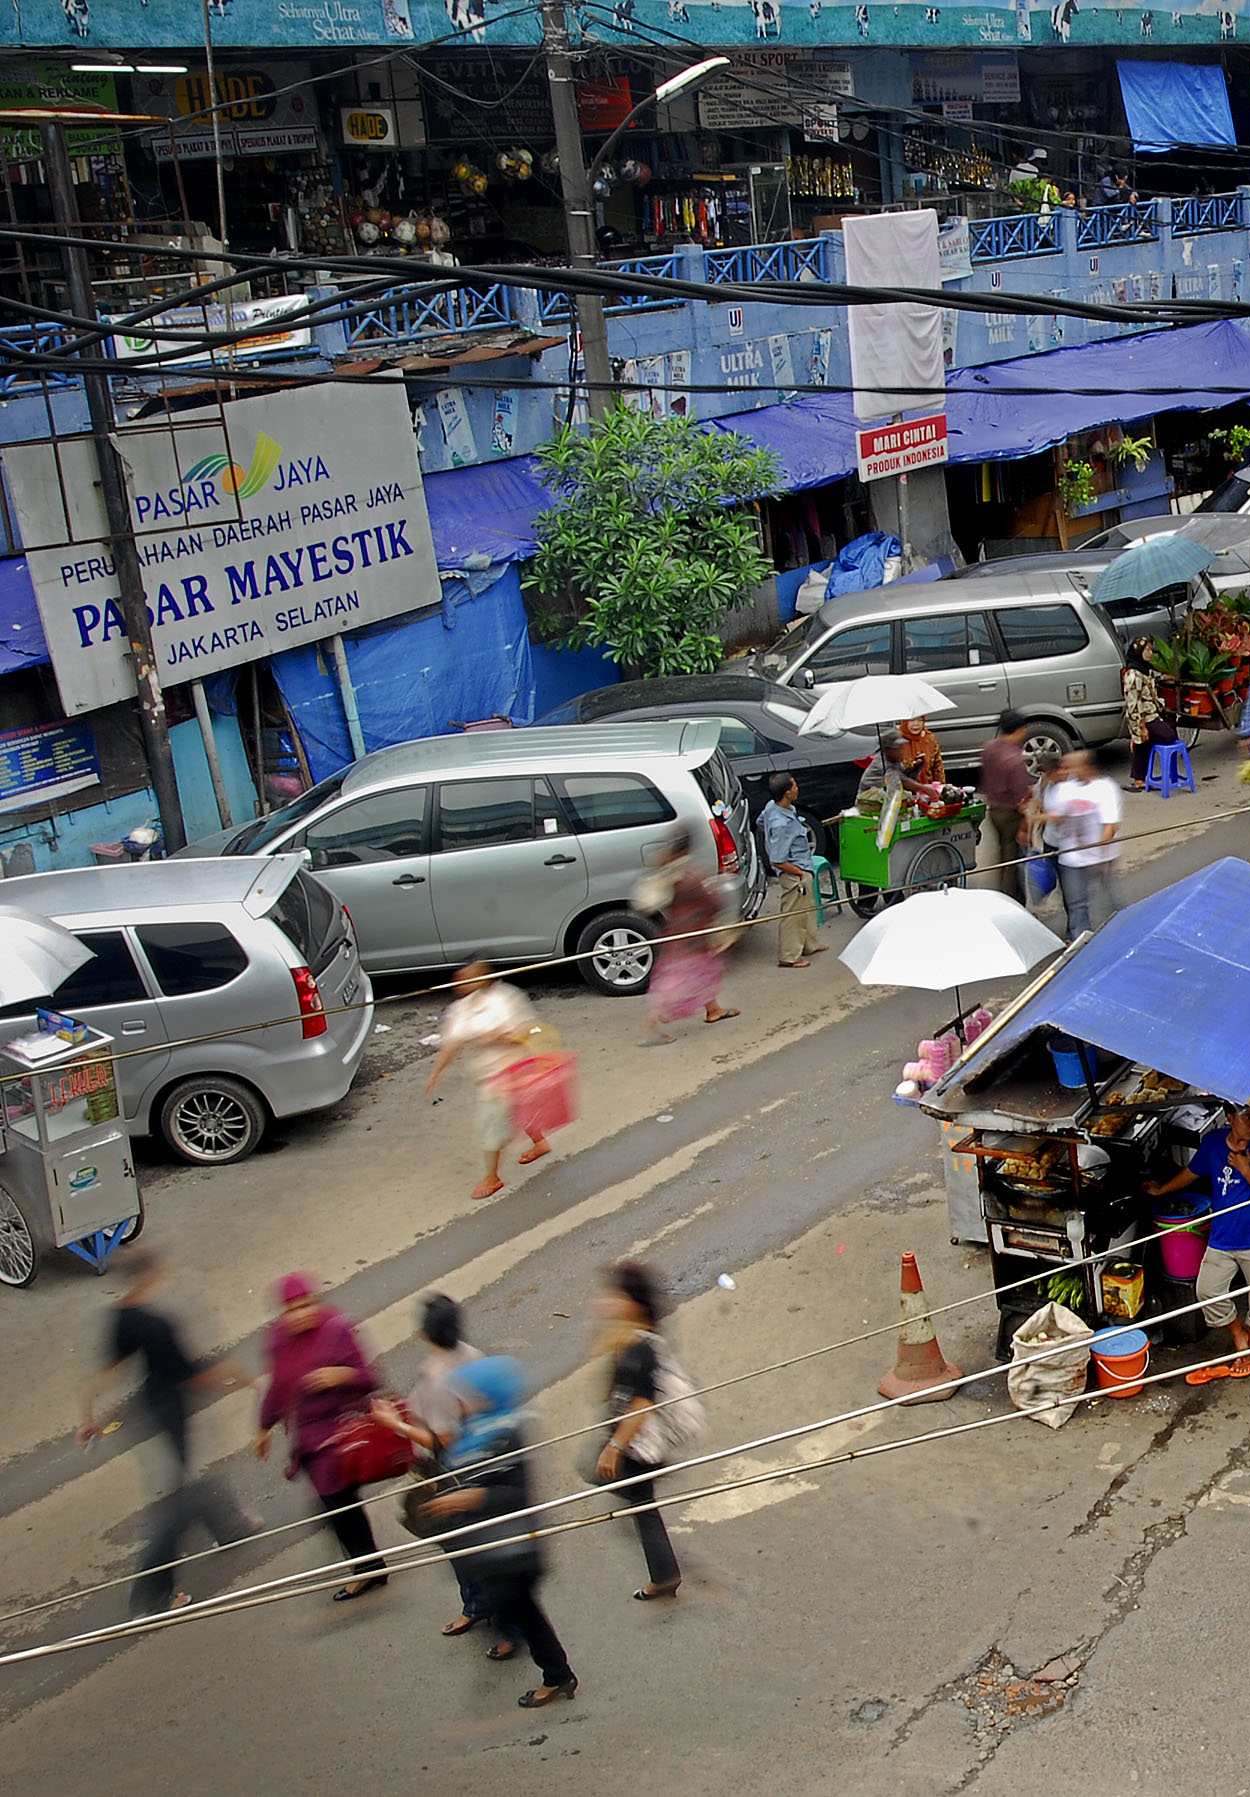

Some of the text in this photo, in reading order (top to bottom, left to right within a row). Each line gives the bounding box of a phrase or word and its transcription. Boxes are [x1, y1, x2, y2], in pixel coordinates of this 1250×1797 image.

[39, 86, 100, 99] REKLAME
[349, 112, 384, 140] HADE
[988, 324, 1015, 345] MILK
[720, 349, 764, 374] ULTRA
[873, 423, 936, 453] MARI CINTAI
[273, 455, 331, 492] JAYA
[867, 445, 945, 476] PRODUK INDONESIA
[134, 480, 221, 524] PASAR
[60, 482, 405, 587] PERUHAAN DAERAH PASAR JAYA
[73, 519, 414, 649] PAAR MAYESTIK
[166, 590, 360, 666] JAKARTA SELATAN
[50, 1064, 108, 1106] LEKKER
